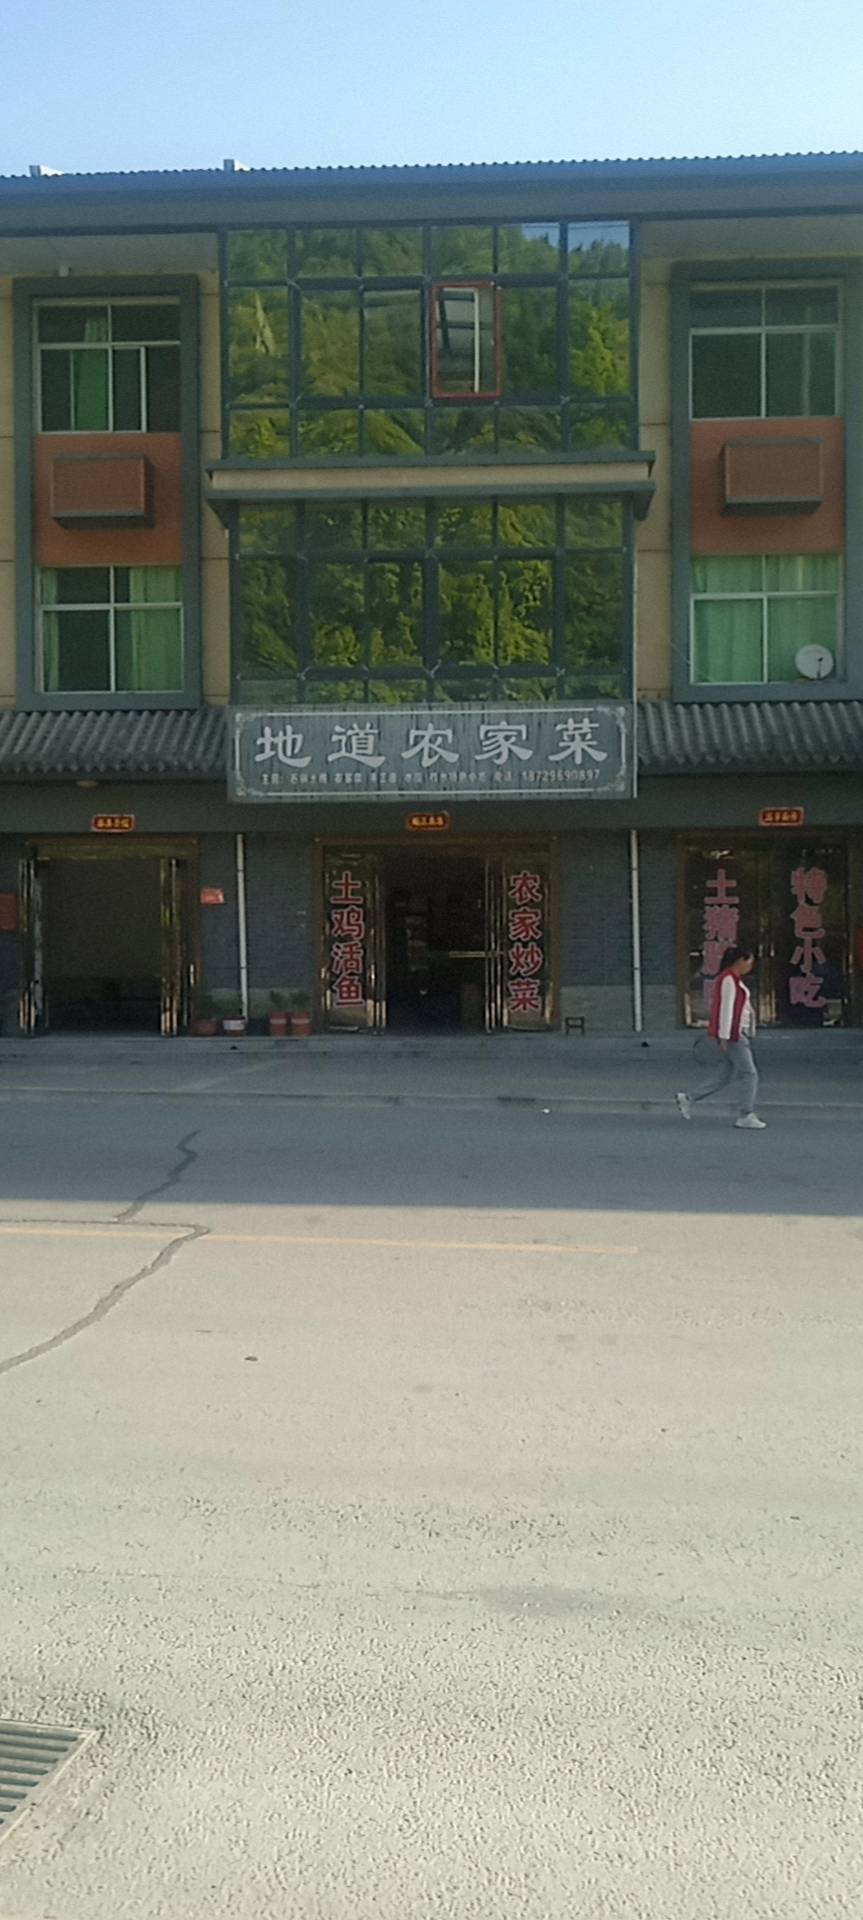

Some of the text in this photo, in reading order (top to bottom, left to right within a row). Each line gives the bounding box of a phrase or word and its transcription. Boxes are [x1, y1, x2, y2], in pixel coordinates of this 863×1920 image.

[254, 717, 608, 768] 地道农家菜
[330, 871, 366, 1008] 土鸡活鱼
[508, 871, 543, 1013] 农家炒菜
[789, 867, 827, 1008] 特色小吃
